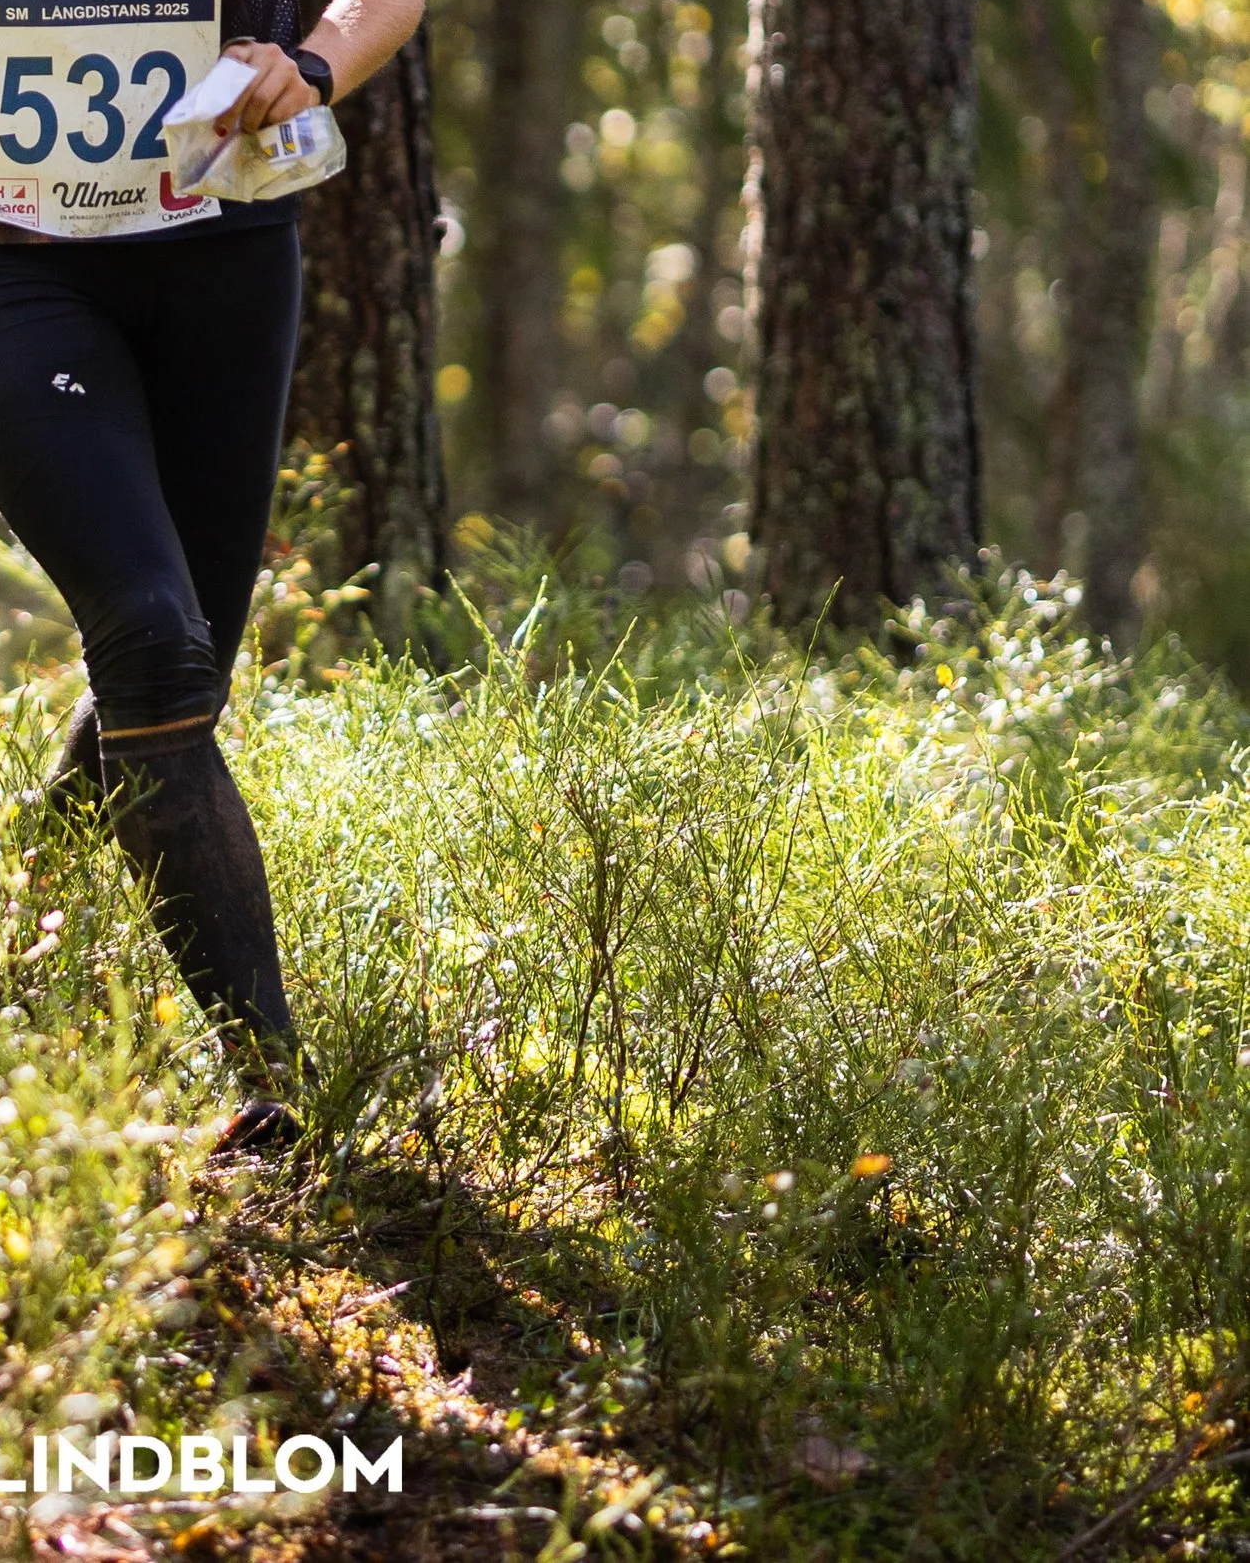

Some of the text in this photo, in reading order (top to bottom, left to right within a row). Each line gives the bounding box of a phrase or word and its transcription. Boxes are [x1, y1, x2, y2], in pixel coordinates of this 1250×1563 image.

[5, 2, 190, 21] SM LÅNGDISTANS 2025
[52, 182, 146, 209] Ullmax
